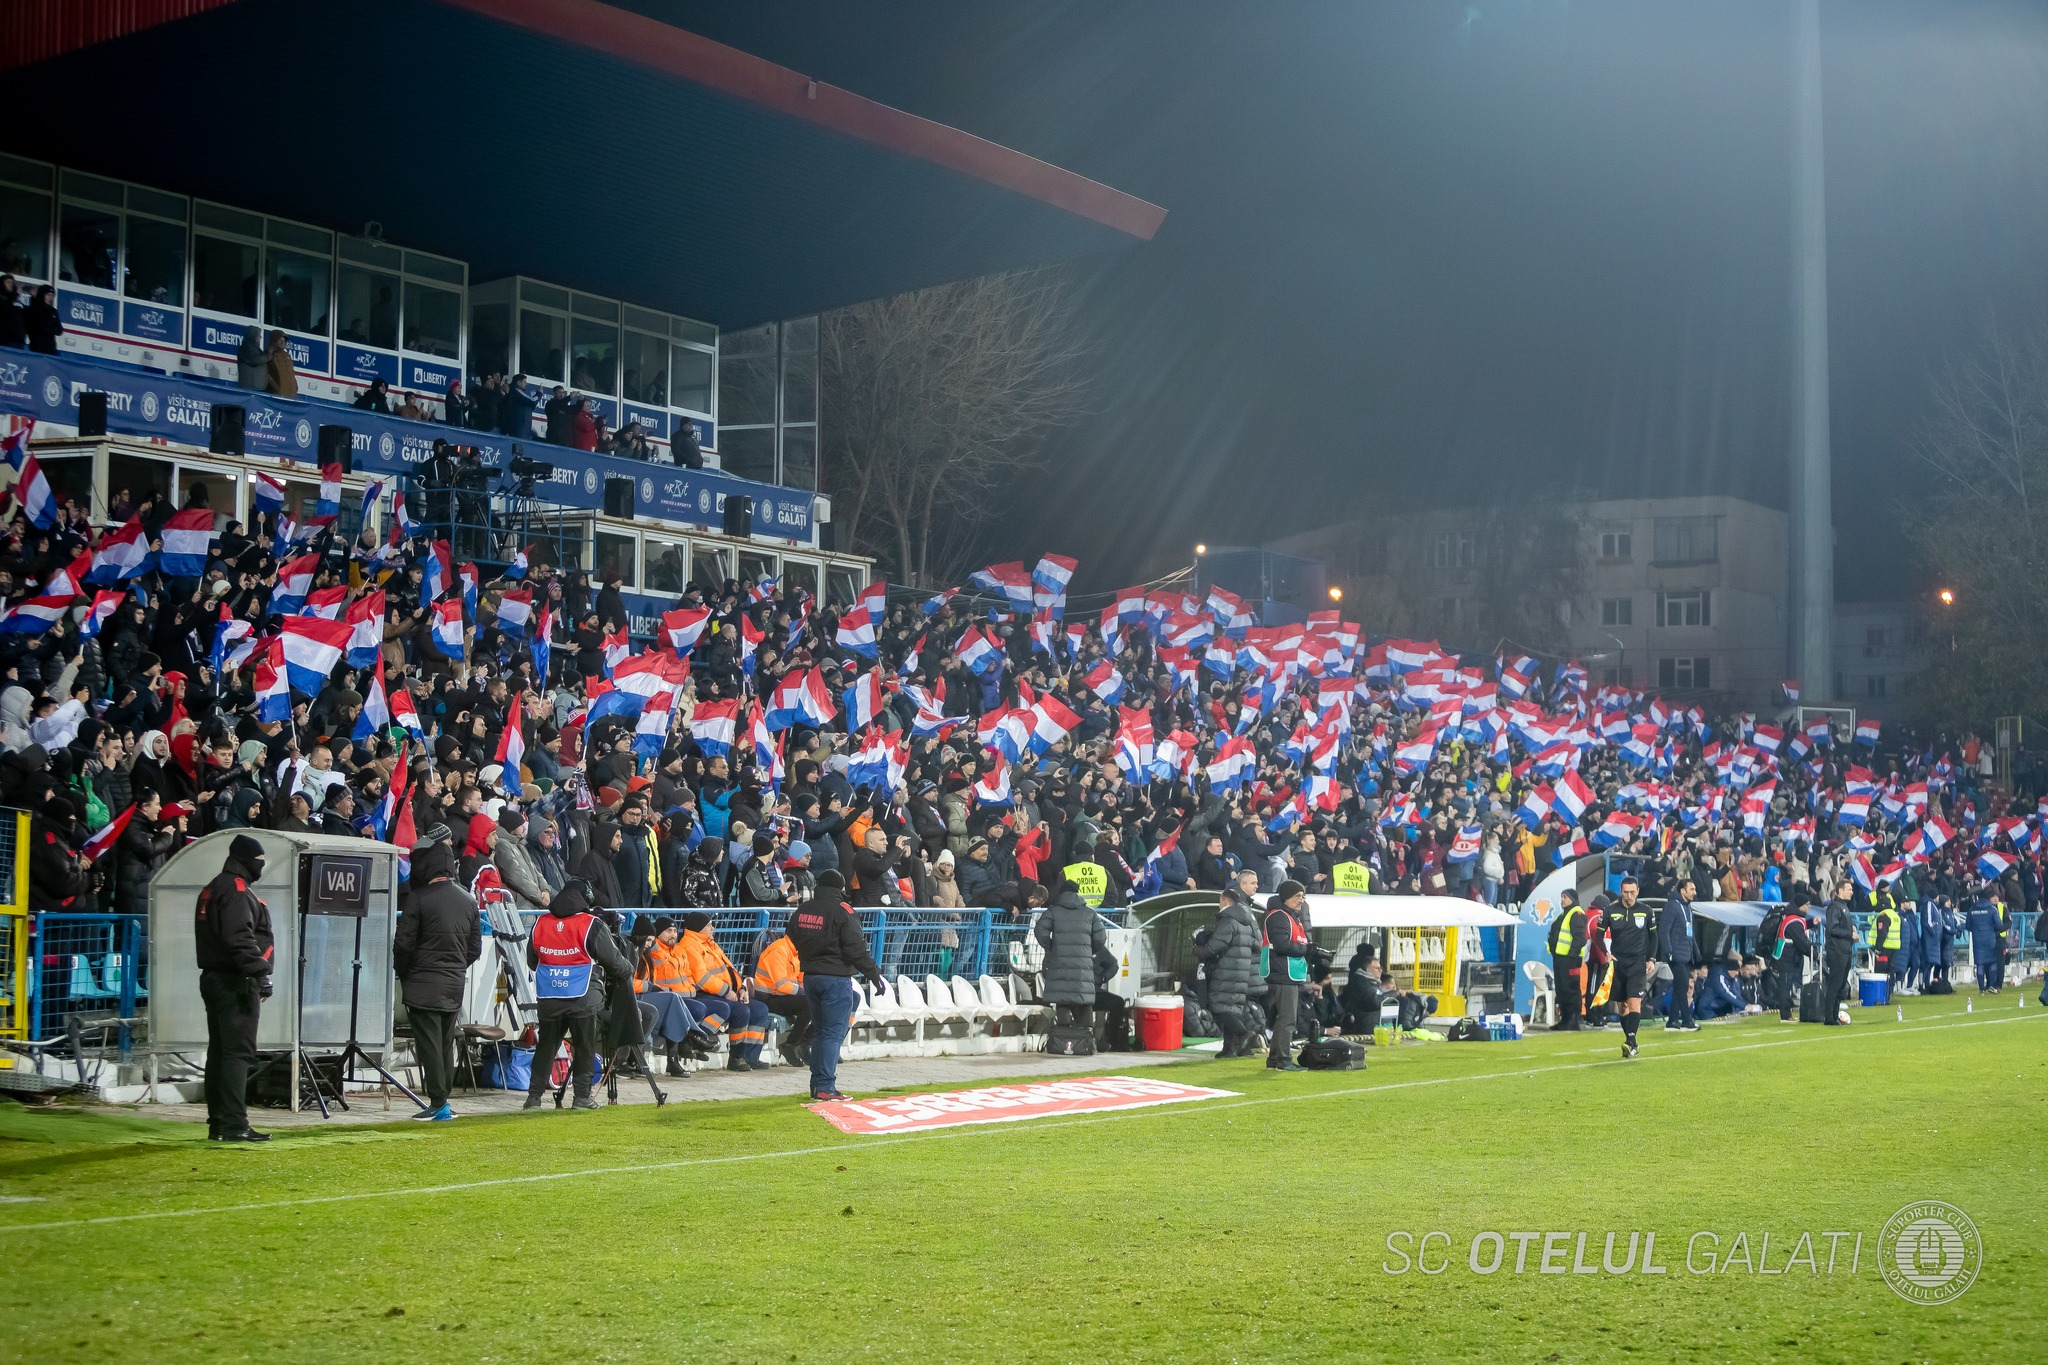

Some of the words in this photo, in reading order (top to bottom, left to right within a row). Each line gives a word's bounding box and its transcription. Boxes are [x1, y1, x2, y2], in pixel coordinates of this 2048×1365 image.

[217, 331, 244, 346] LIBERTY
[283, 348, 309, 366] ALAȚI
[423, 371, 447, 386] LIBERTY
[167, 394, 186, 407] visit
[402, 434, 418, 447] visit
[552, 467, 579, 486] BERTY
[630, 615, 663, 634] LIBERT
[1081, 867, 1093, 876] 02
[327, 871, 355, 892] VAR
[1077, 877, 1098, 885] ORDINE
[1343, 881, 1364, 889] MMA
[540, 946, 580, 956] SUPERLIGA
[549, 968, 570, 977] TV-B
[551, 979, 569, 988] 056
[842, 1080, 1184, 1129] SUPERBET
